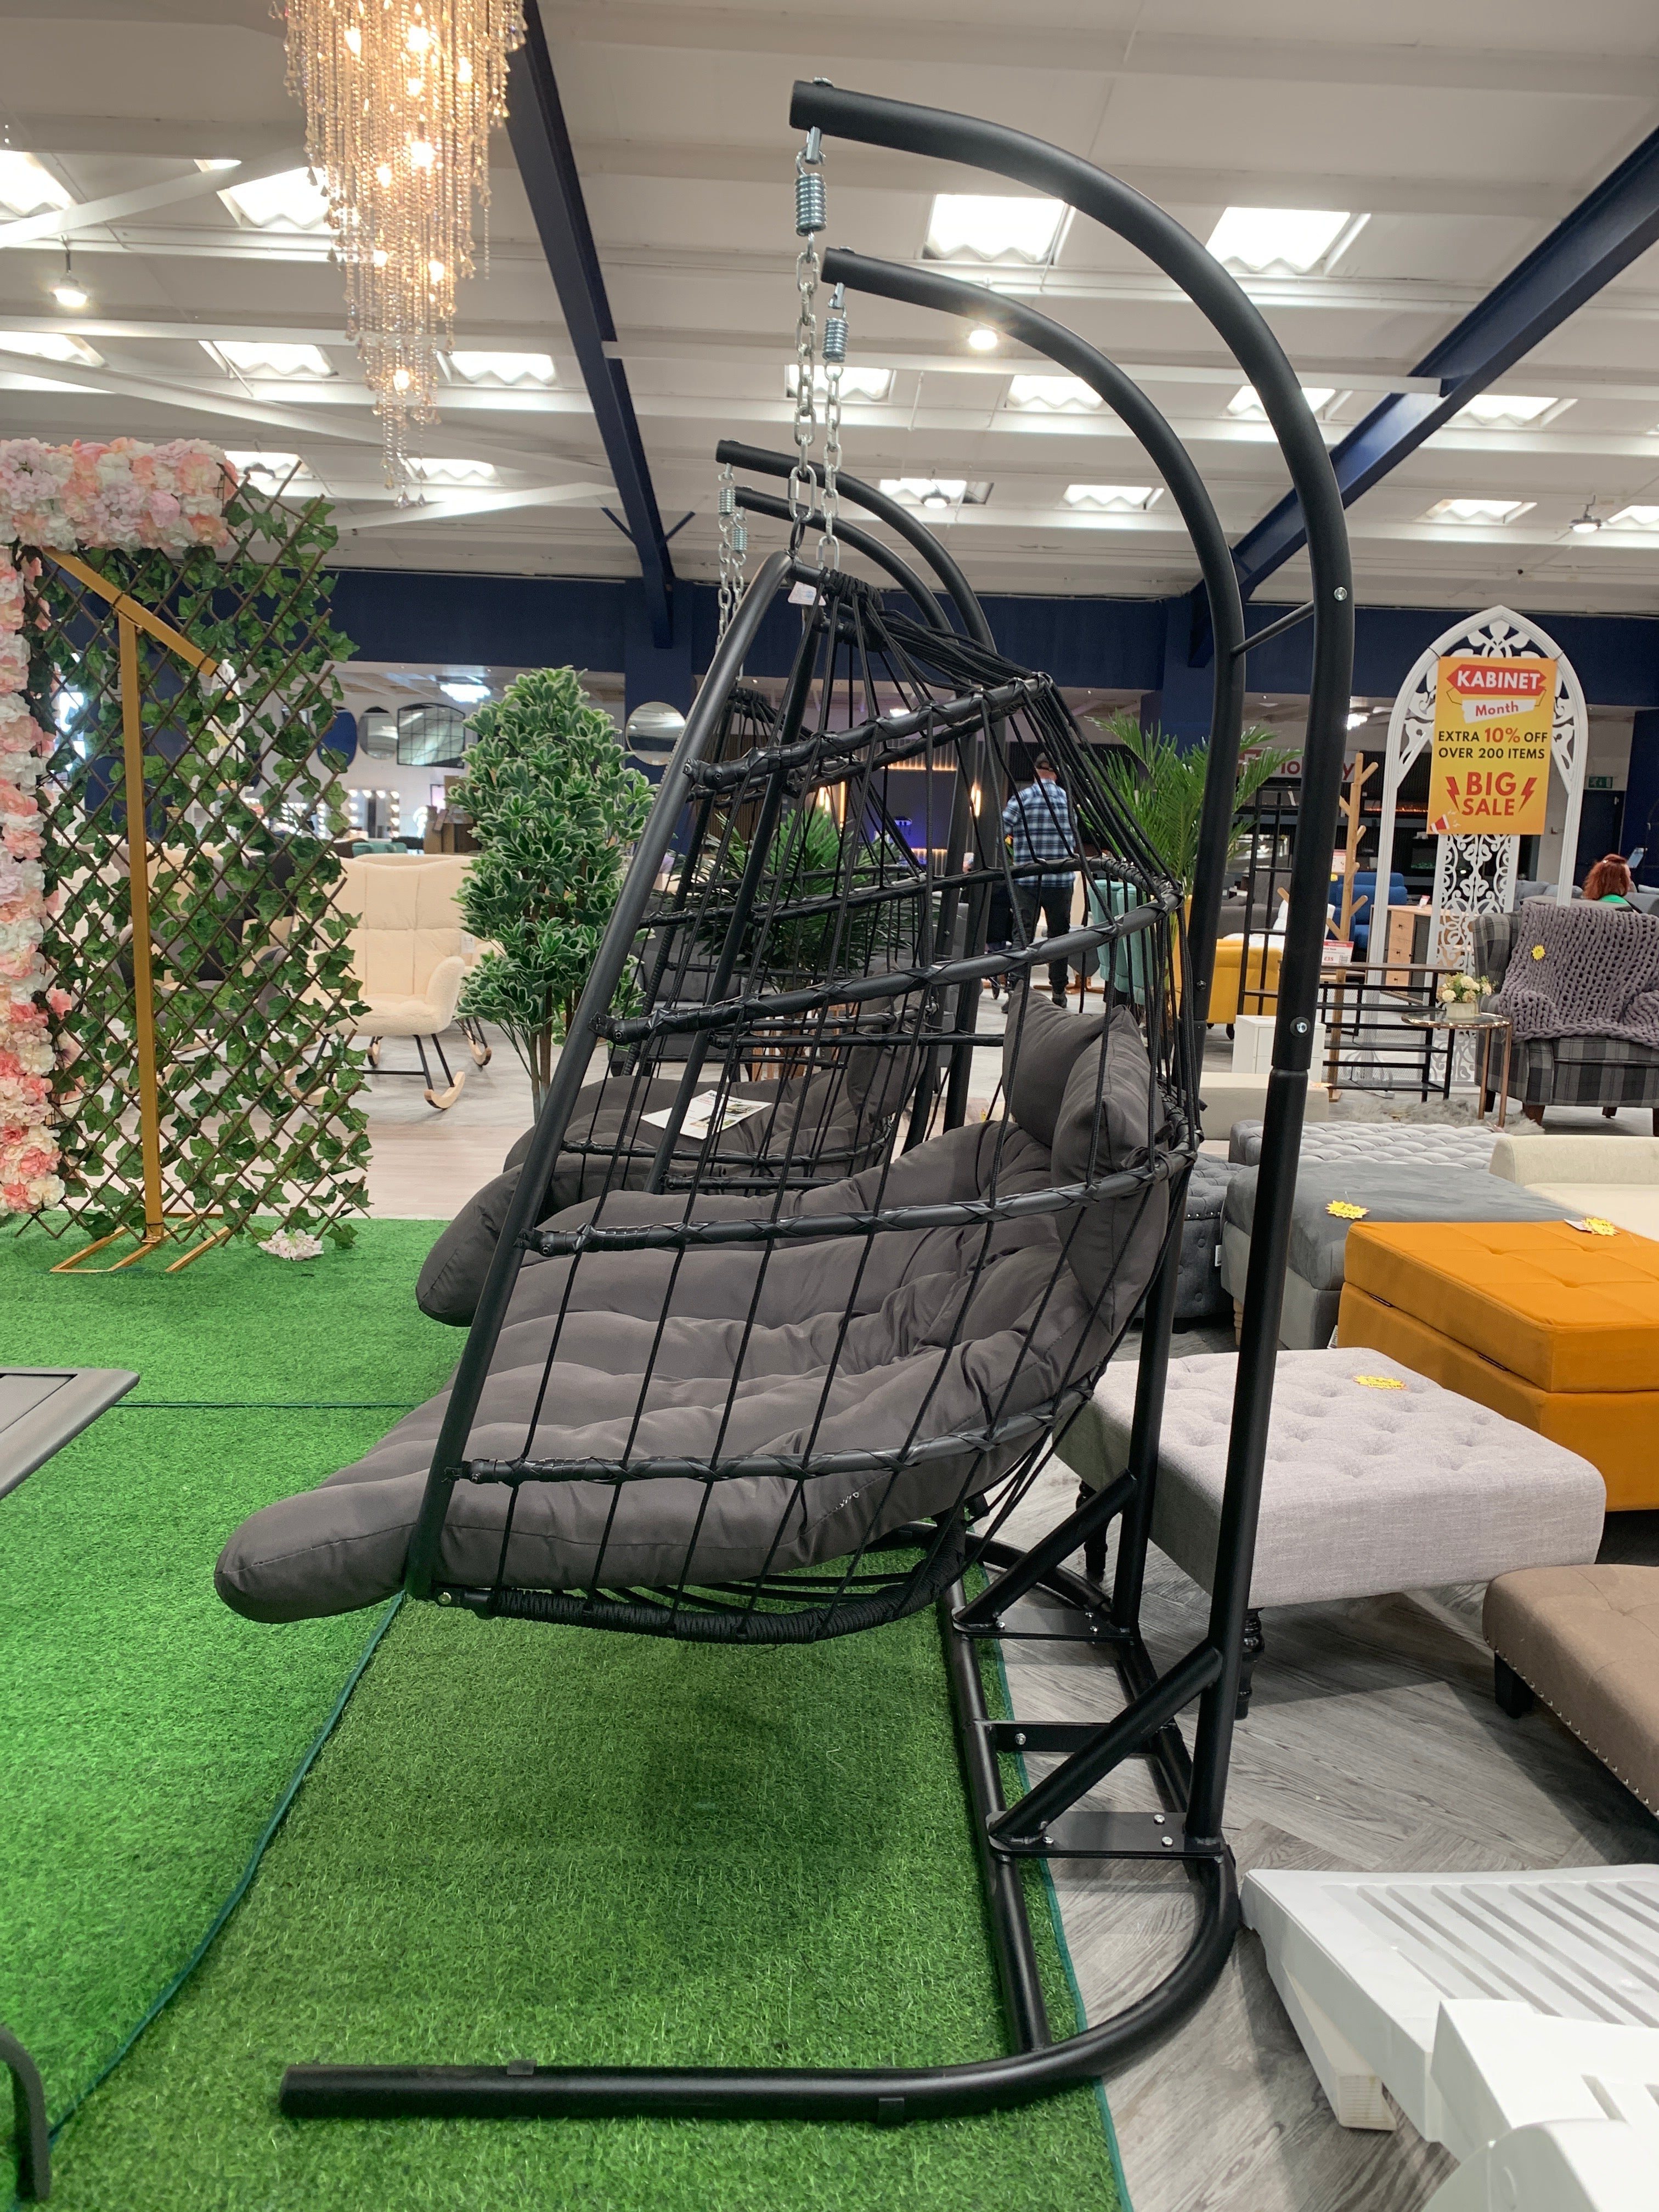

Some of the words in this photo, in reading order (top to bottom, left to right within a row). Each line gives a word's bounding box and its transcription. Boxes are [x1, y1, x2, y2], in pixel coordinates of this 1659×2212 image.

[1457, 670, 1541, 690] KABINET
[1476, 701, 1519, 716] Month
[1438, 731, 1480, 742] EXTRA
[1485, 727, 1520, 743] 10%
[1524, 732, 1548, 742] OFF
[1438, 748, 1473, 758] OVER
[1478, 748, 1504, 758] 200
[1509, 748, 1544, 759] ITEMS
[1466, 771, 1516, 796] BIG
[1462, 798, 1515, 816] SALE
